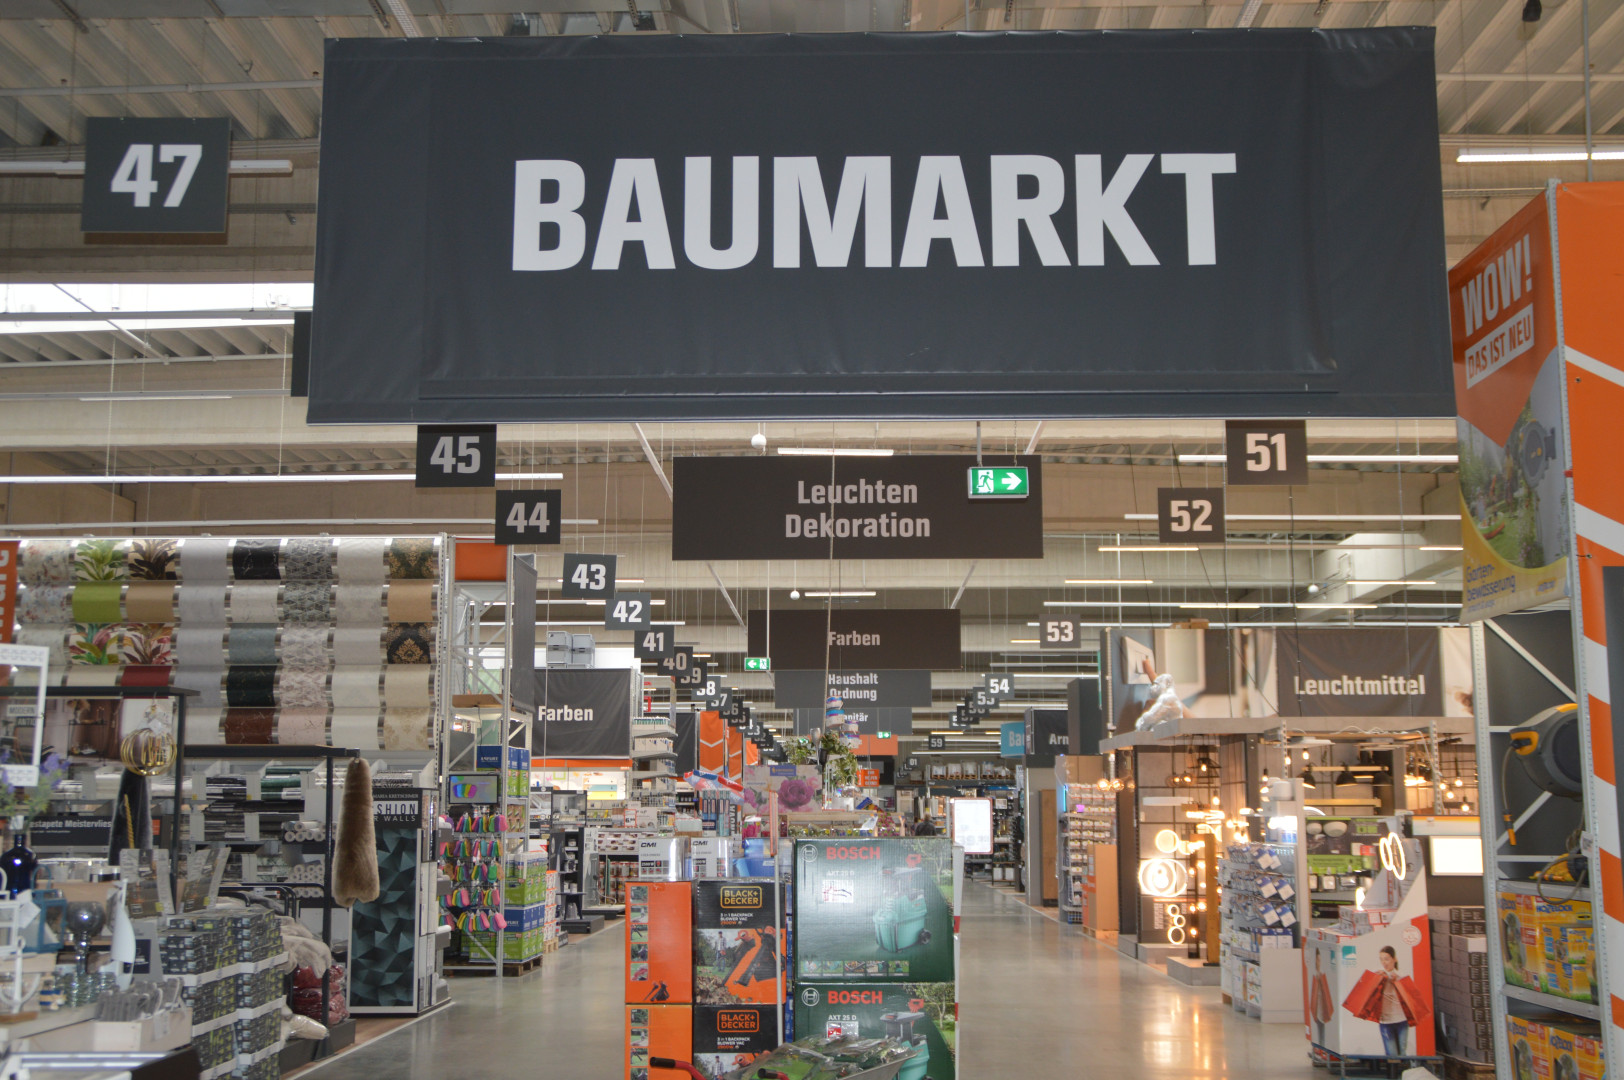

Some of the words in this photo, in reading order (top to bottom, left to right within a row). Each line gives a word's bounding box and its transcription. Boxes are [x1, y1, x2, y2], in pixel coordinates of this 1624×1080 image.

[109, 143, 203, 207] 47
[511, 152, 1238, 272] BAUMARKT
[1461, 233, 1533, 338] WOW!
[1468, 344, 1488, 379] DAS
[1489, 333, 1506, 363] IST
[1509, 313, 1532, 352] NEU
[430, 435, 481, 474] 45
[1246, 433, 1287, 472] 51
[797, 478, 918, 504] Leuchten
[506, 502, 550, 534] 44
[785, 512, 931, 538] Dekoration
[1170, 499, 1213, 532] 52
[571, 564, 607, 591] 43
[612, 600, 643, 623] 42
[828, 630, 881, 647] Farben
[1046, 621, 1074, 643] 53
[643, 632, 665, 652] 41
[662, 652, 687, 671] 40
[828, 672, 879, 685] Haushalt
[990, 678, 1010, 694] 54
[1293, 674, 1426, 696] Leuchtmittel
[830, 688, 878, 702] Ordnung
[538, 704, 594, 722] Farben
[843, 712, 869, 722] anitär
[930, 738, 943, 748] 59
[1008, 730, 1025, 748] Ba
[376, 803, 416, 815] SHION
[64, 819, 112, 828] Meistervlies
[826, 846, 881, 860] BOSCH
[724, 897, 759, 905] DECKER
[827, 990, 883, 1004] BOSCH
[721, 1013, 756, 1021] BLACK+
[721, 1021, 756, 1029] DECKER
